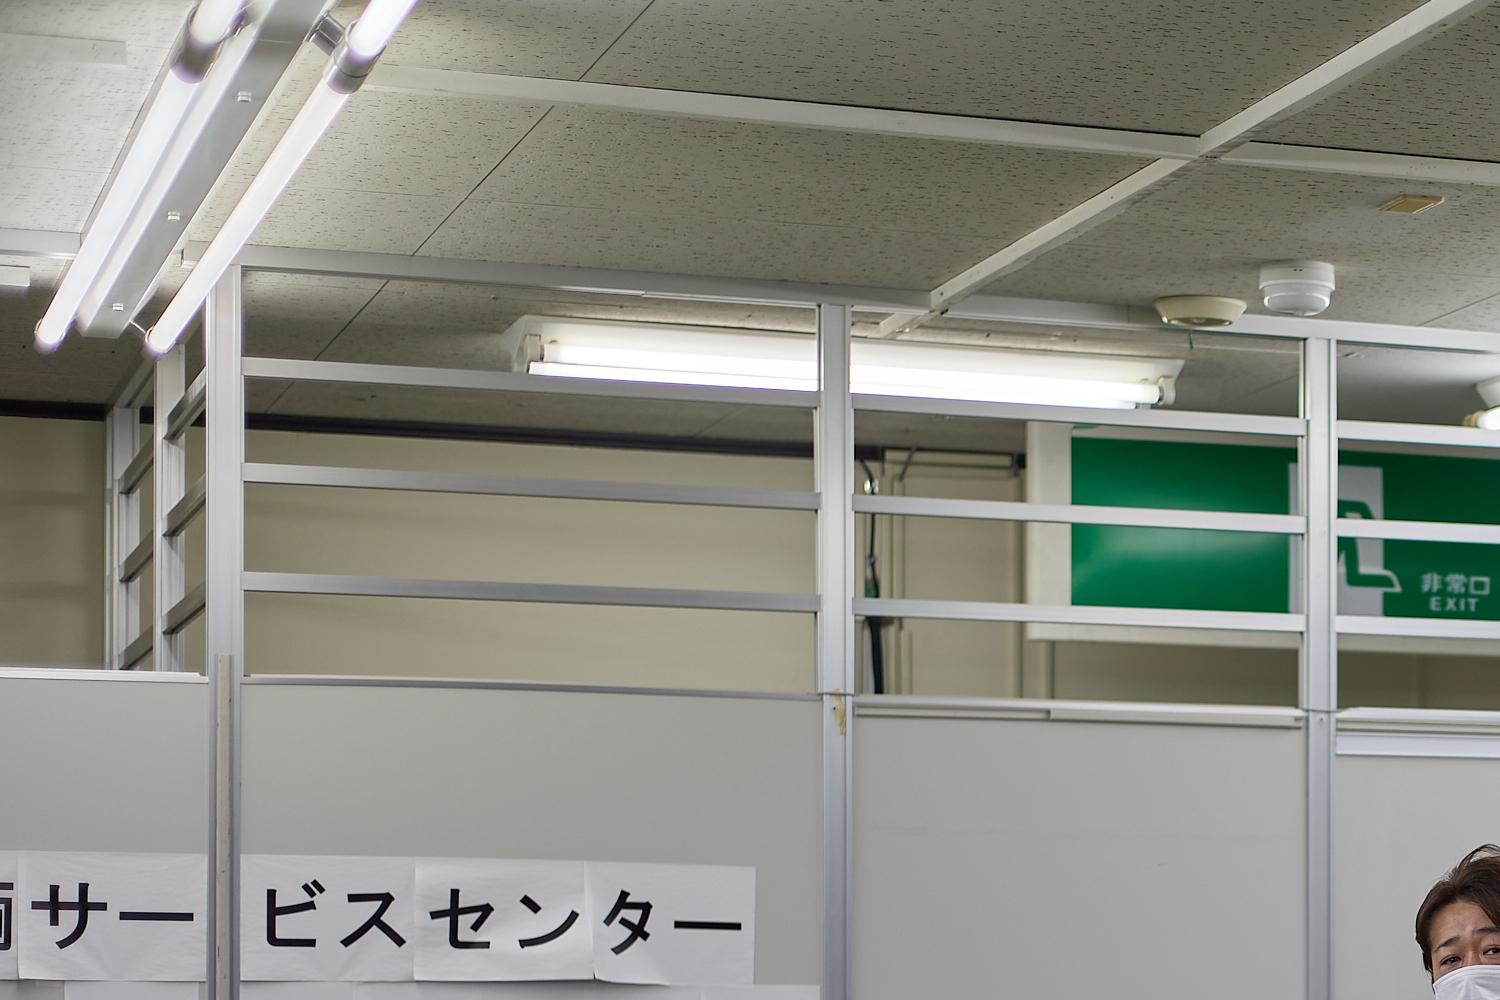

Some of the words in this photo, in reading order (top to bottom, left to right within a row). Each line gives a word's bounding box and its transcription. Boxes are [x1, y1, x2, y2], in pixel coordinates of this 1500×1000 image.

[1421, 572, 1490, 596] 非常口
[1430, 596, 1479, 612] EXIT
[0, 879, 742, 956] サービスセンター
